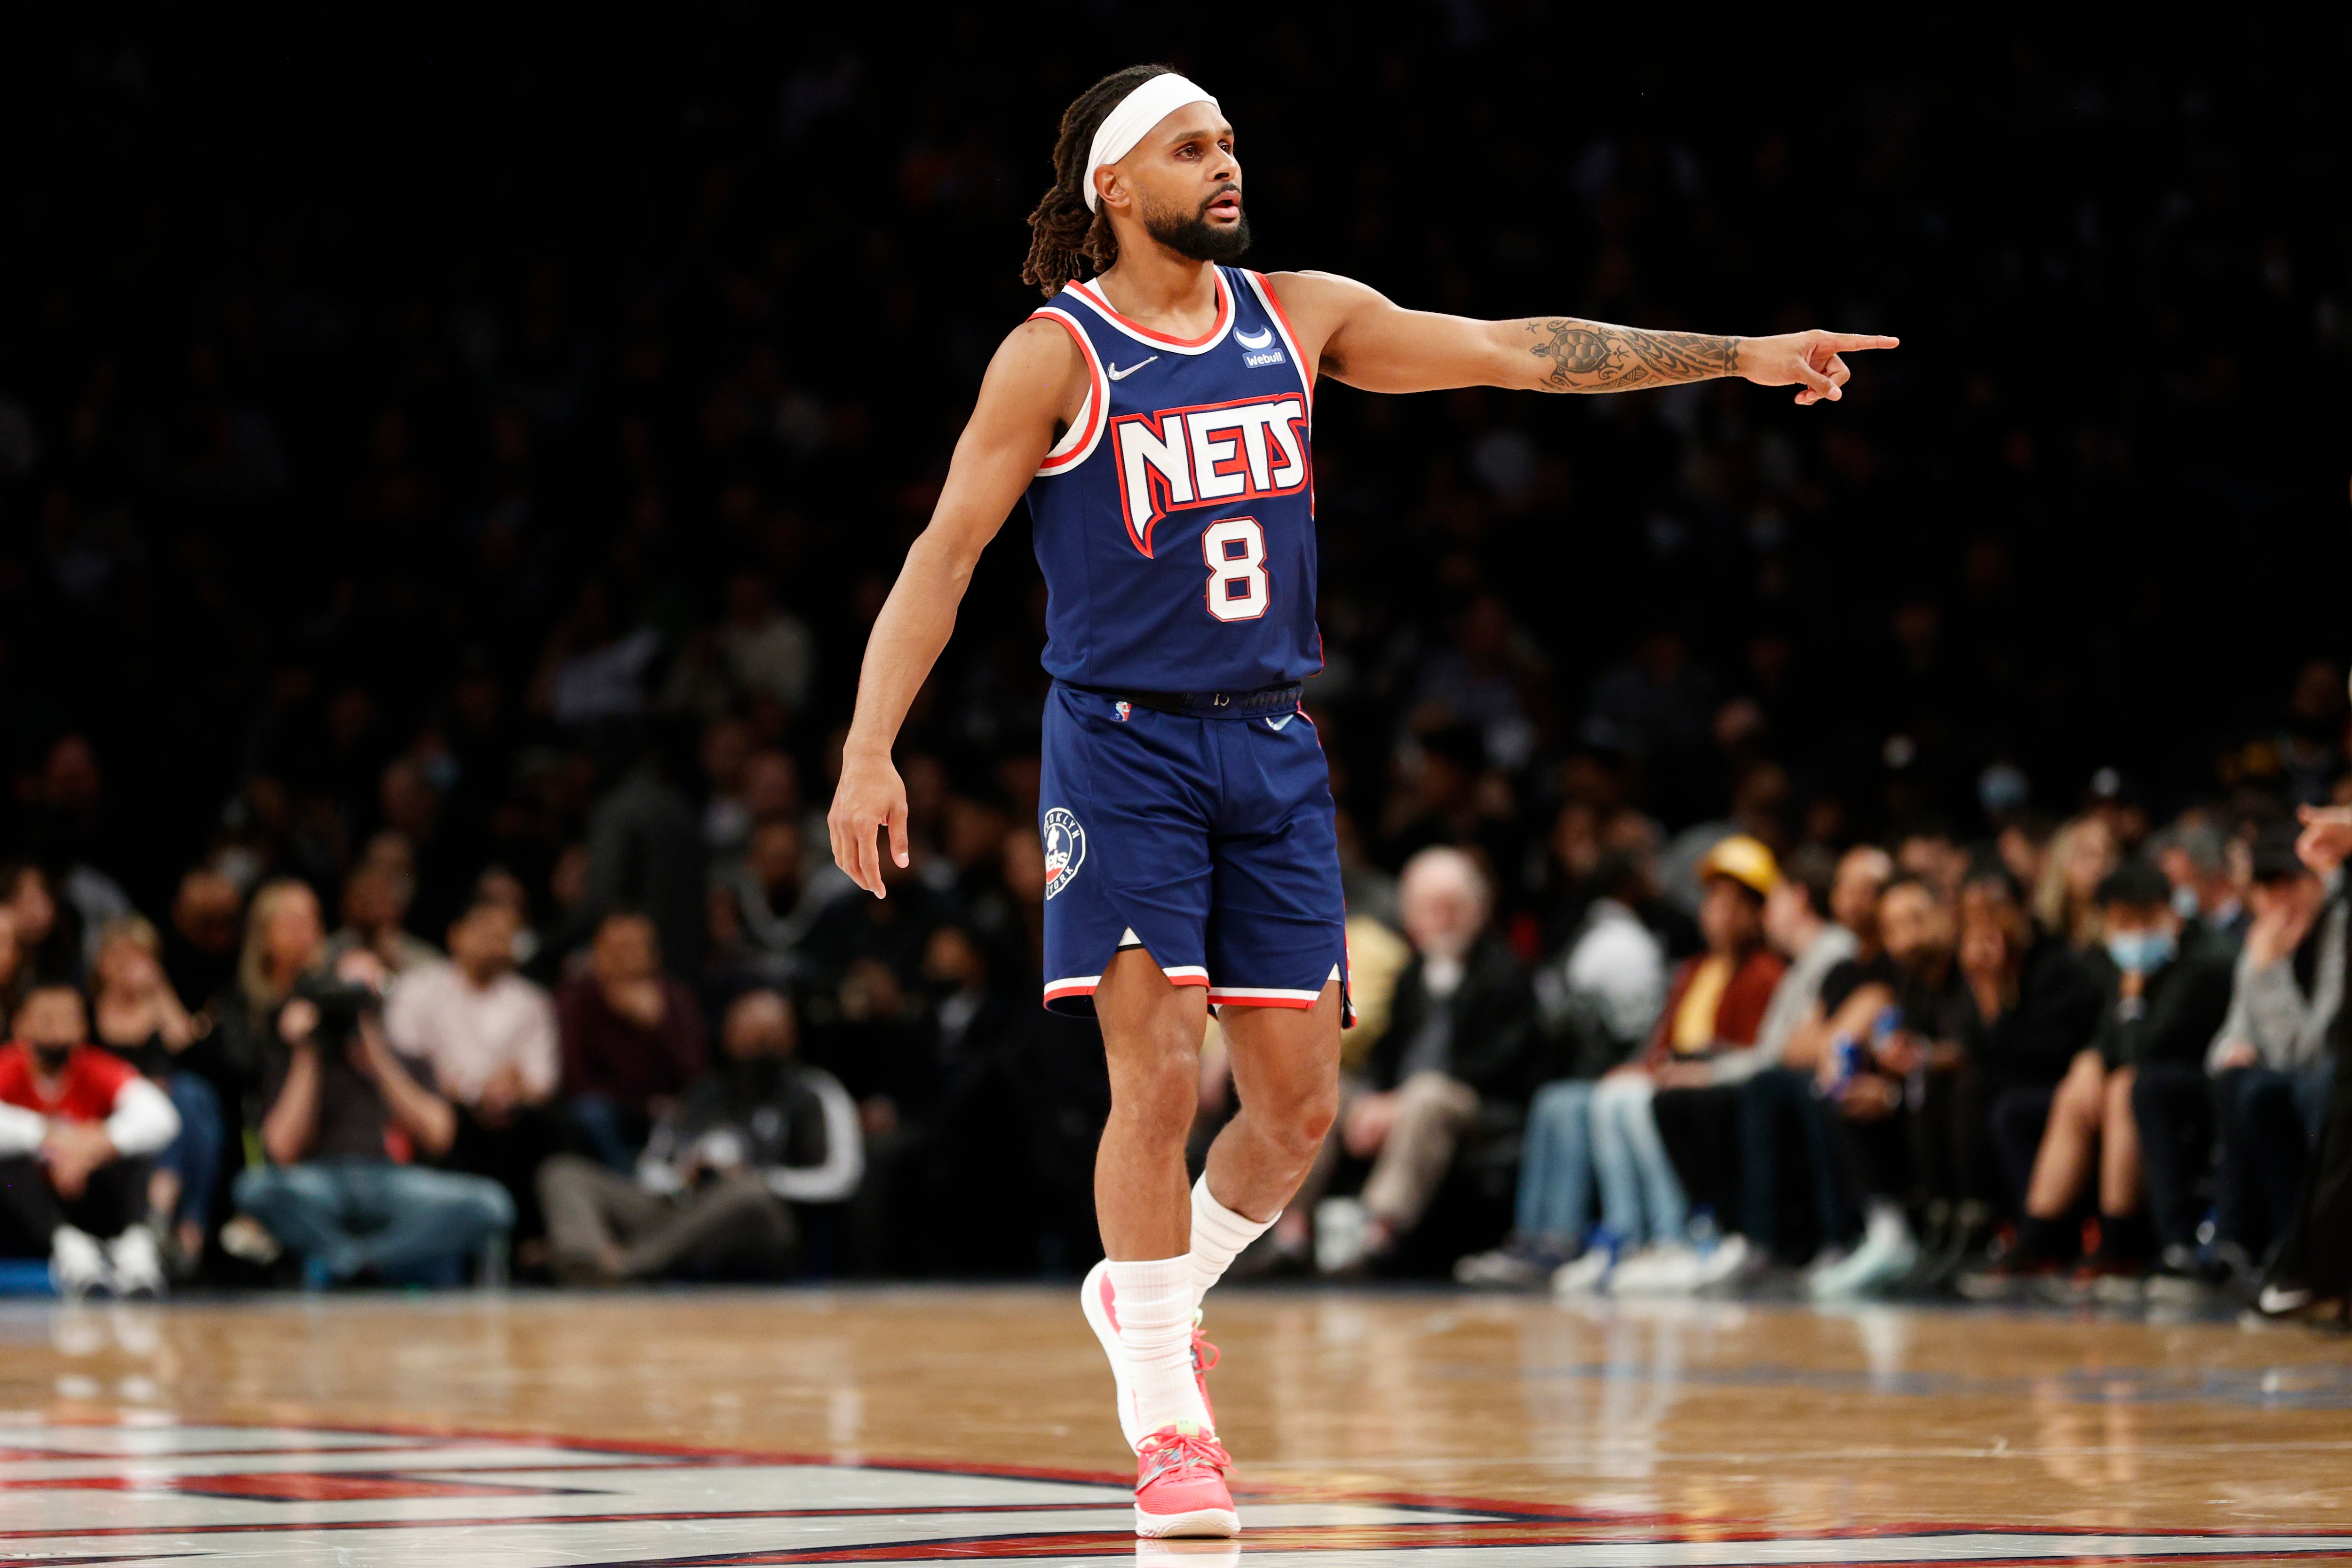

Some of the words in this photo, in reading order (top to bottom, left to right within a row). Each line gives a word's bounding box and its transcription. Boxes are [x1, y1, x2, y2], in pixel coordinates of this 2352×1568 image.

[1247, 352, 1283, 366] Webull
[1110, 394, 1307, 558] NETS
[1202, 516, 1270, 622] 8
[1049, 866, 1073, 894] YORK
